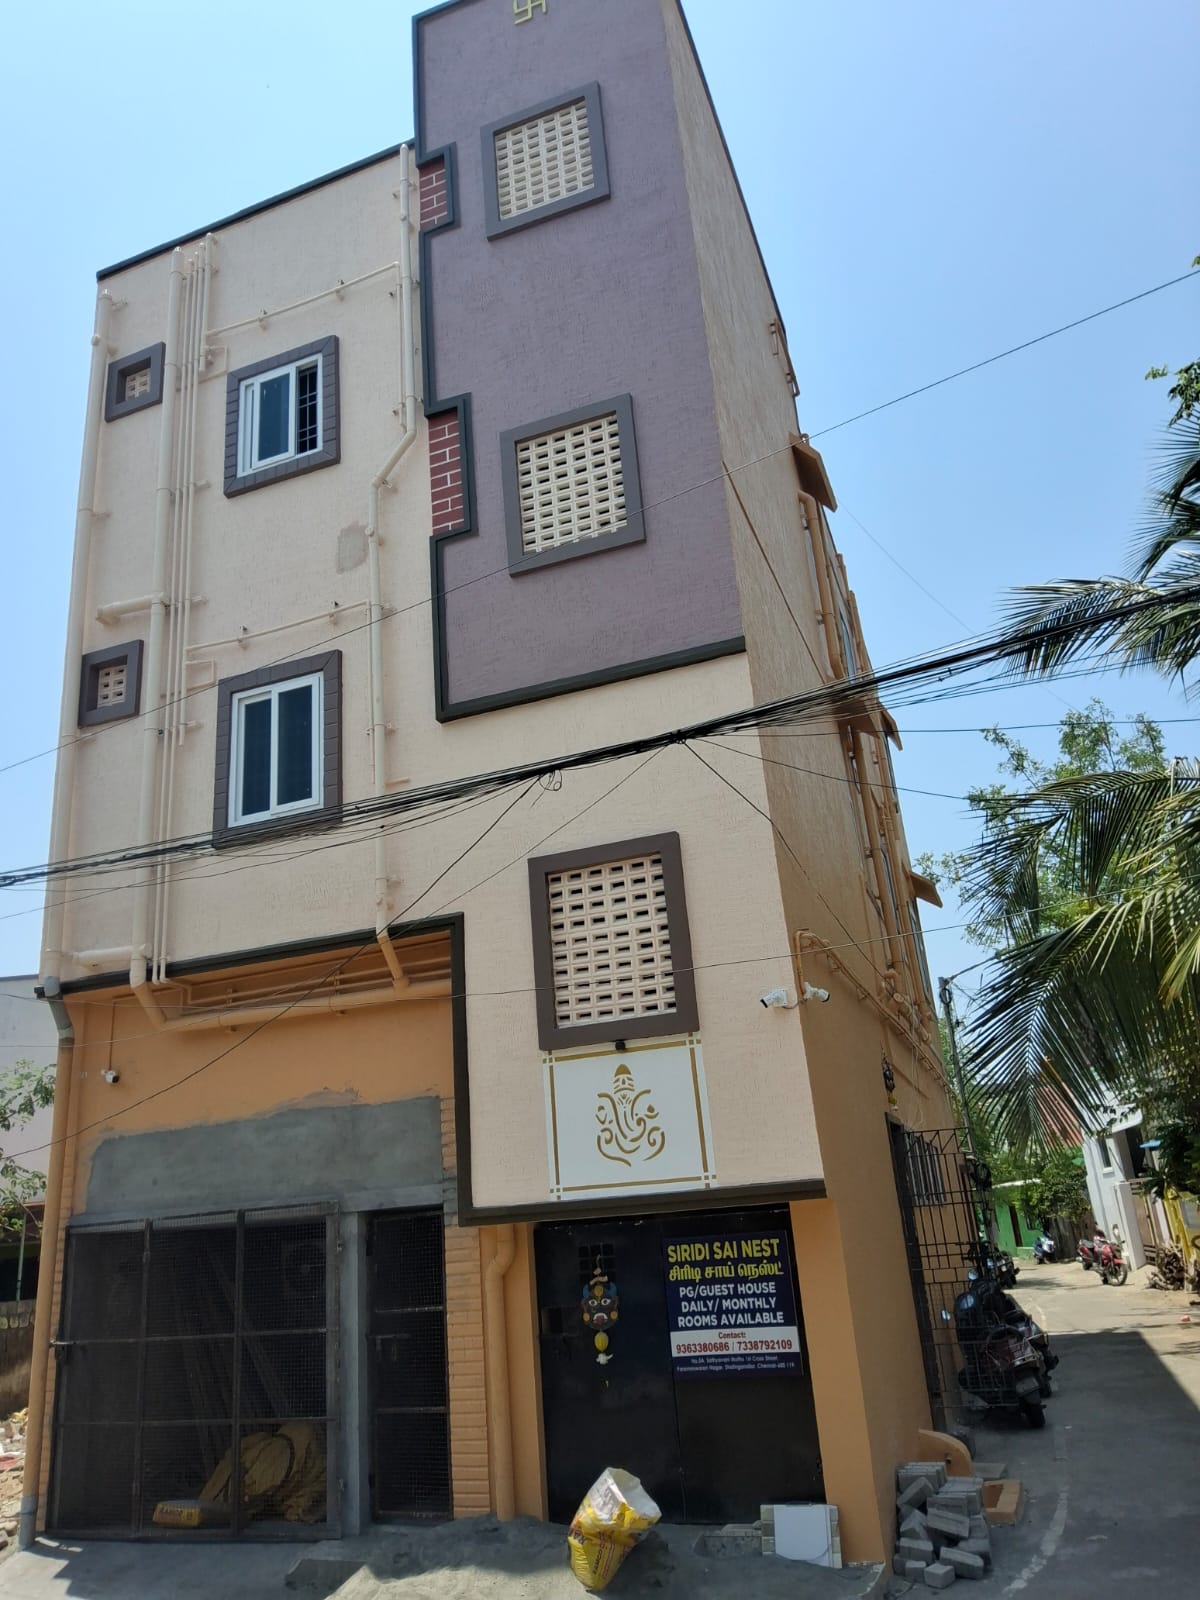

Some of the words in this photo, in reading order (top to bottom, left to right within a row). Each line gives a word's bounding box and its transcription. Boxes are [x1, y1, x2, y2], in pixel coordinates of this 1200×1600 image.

[667, 1243, 710, 1263] SIRIDI
[713, 1241, 737, 1259] SAI
[741, 1239, 779, 1257] NEST
[705, 1261, 734, 1278] சாய்
[679, 1284, 734, 1298] PG/GUEST
[738, 1282, 776, 1294] HOUSE
[681, 1298, 719, 1312] DAILY/
[722, 1297, 776, 1309] MONTHLY
[678, 1315, 717, 1327] ROOMS
[721, 1312, 784, 1326] AVAILABLE
[737, 1340, 792, 1351] 7338792109
